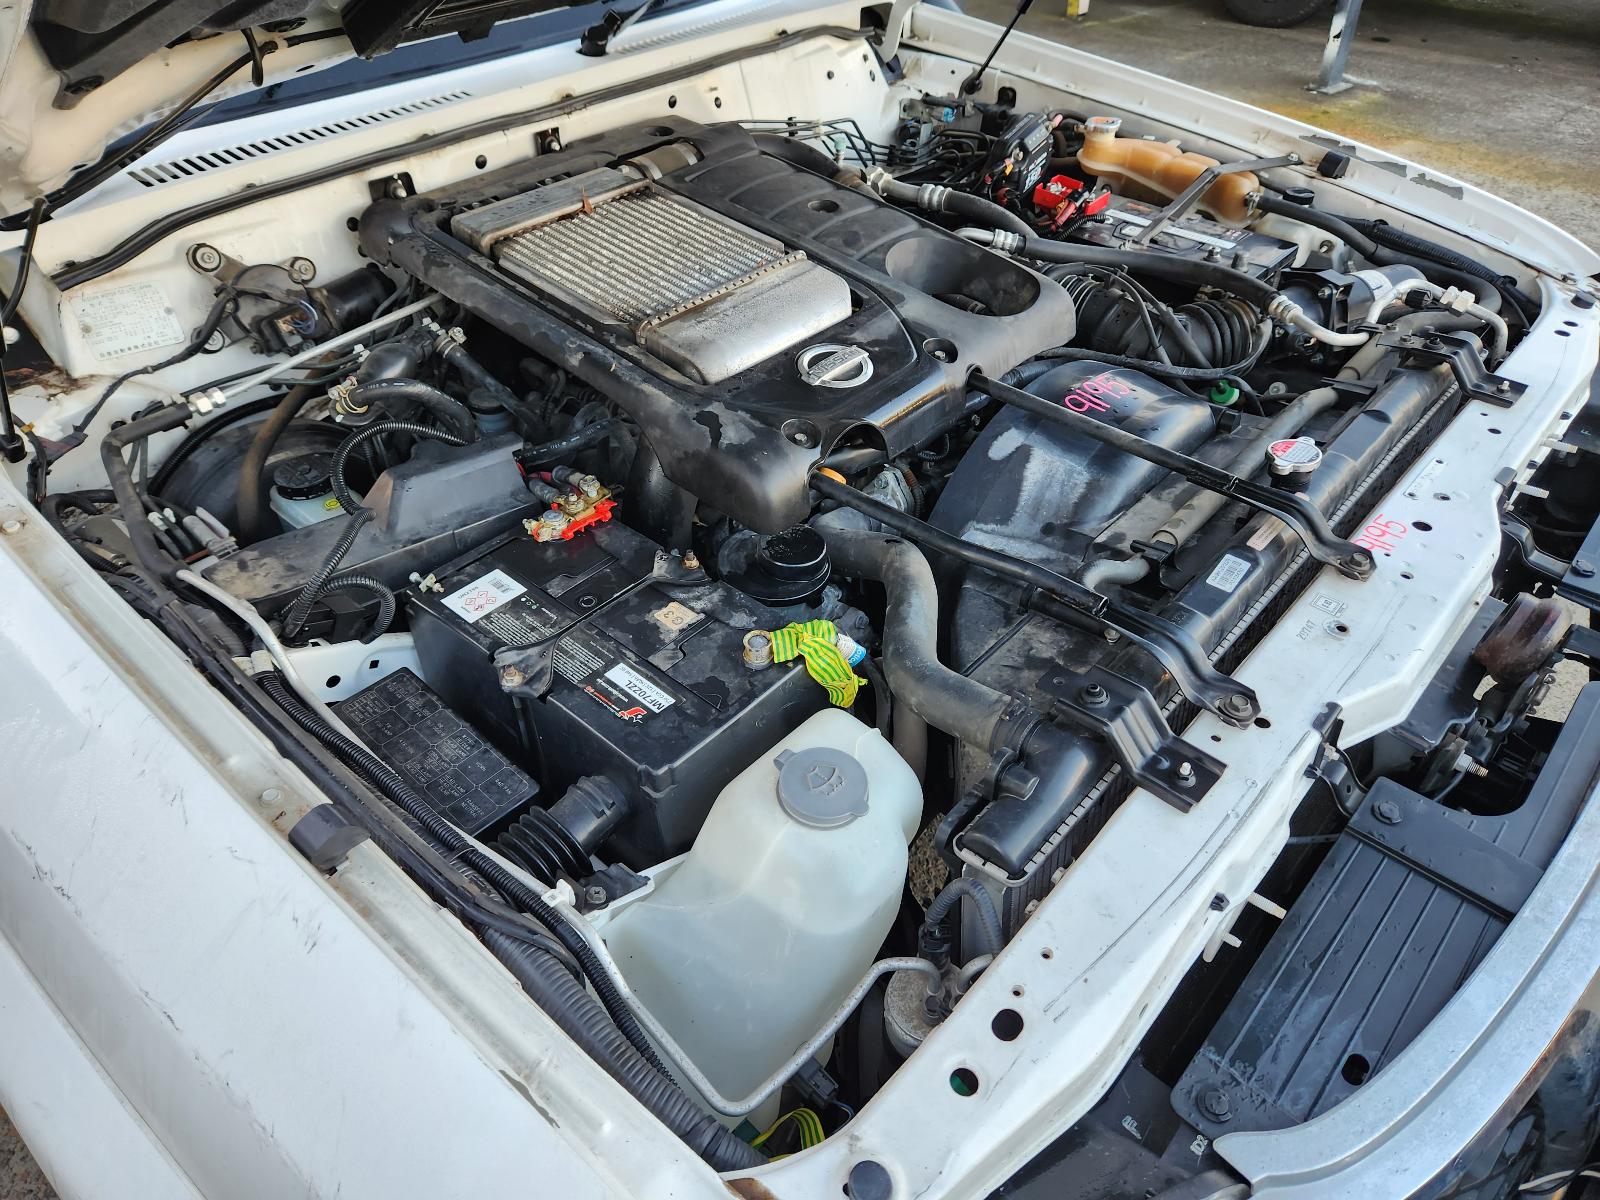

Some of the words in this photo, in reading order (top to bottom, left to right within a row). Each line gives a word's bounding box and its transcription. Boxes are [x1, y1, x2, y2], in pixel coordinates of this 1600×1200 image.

[810, 349, 861, 379] NISSAN
[1064, 372, 1130, 412] 9195
[625, 680, 665, 710] MF70ZZL
